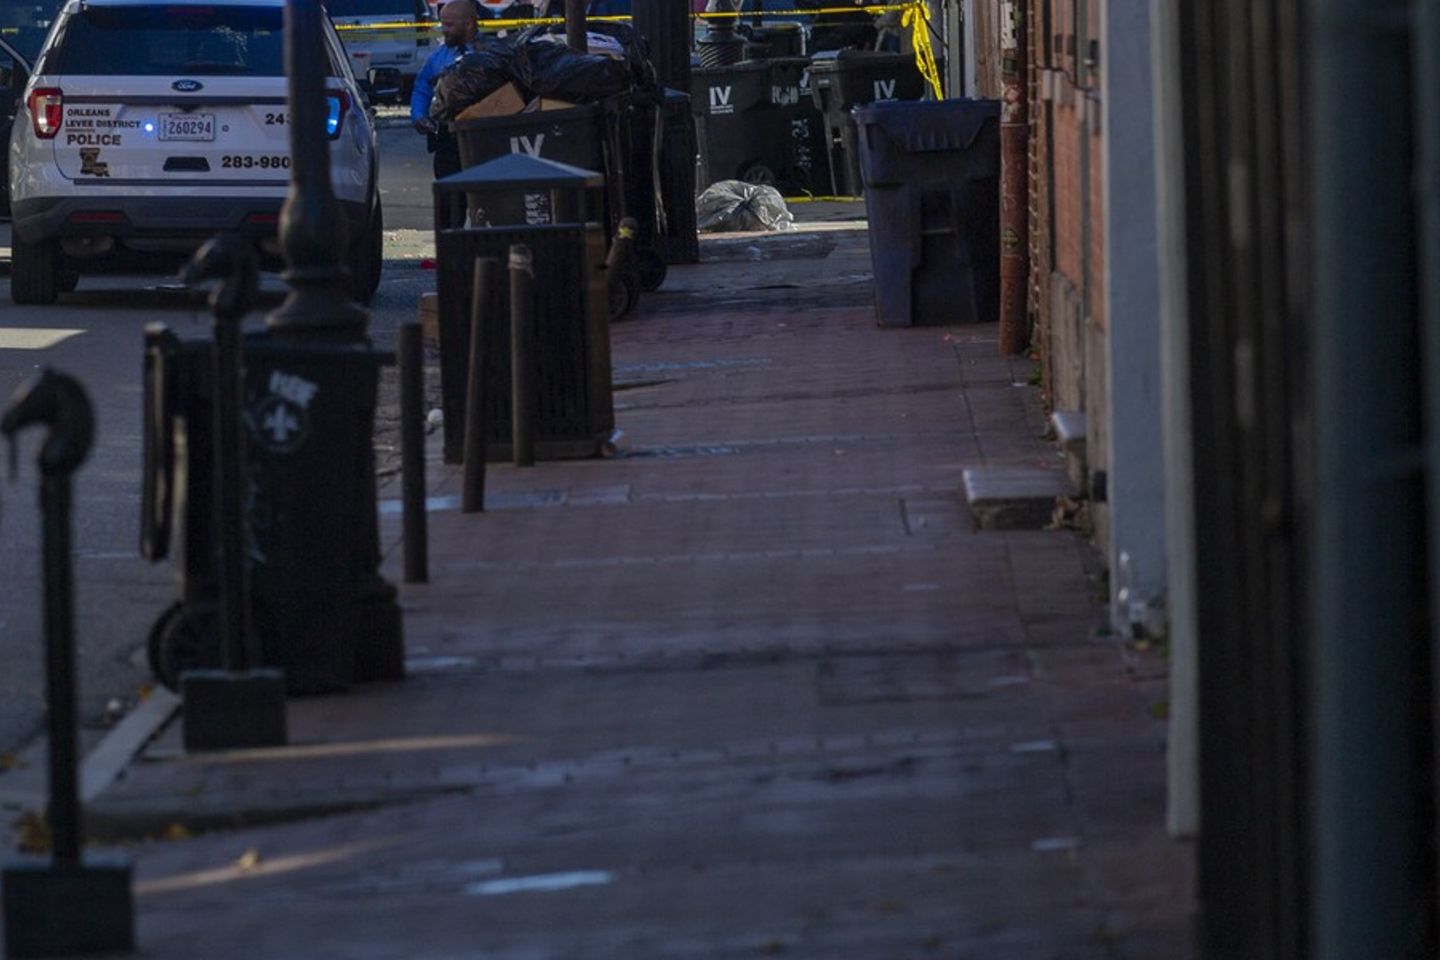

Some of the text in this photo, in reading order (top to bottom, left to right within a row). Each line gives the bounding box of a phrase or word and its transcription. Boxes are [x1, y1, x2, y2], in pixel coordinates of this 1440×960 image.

[710, 86, 732, 106] IV
[67, 108, 111, 117] ORLEANS
[65, 120, 141, 128] LEVEE DISTRICT
[168, 121, 212, 135] 260294
[67, 134, 122, 146] POLICE
[221, 155, 291, 169] 283-980
